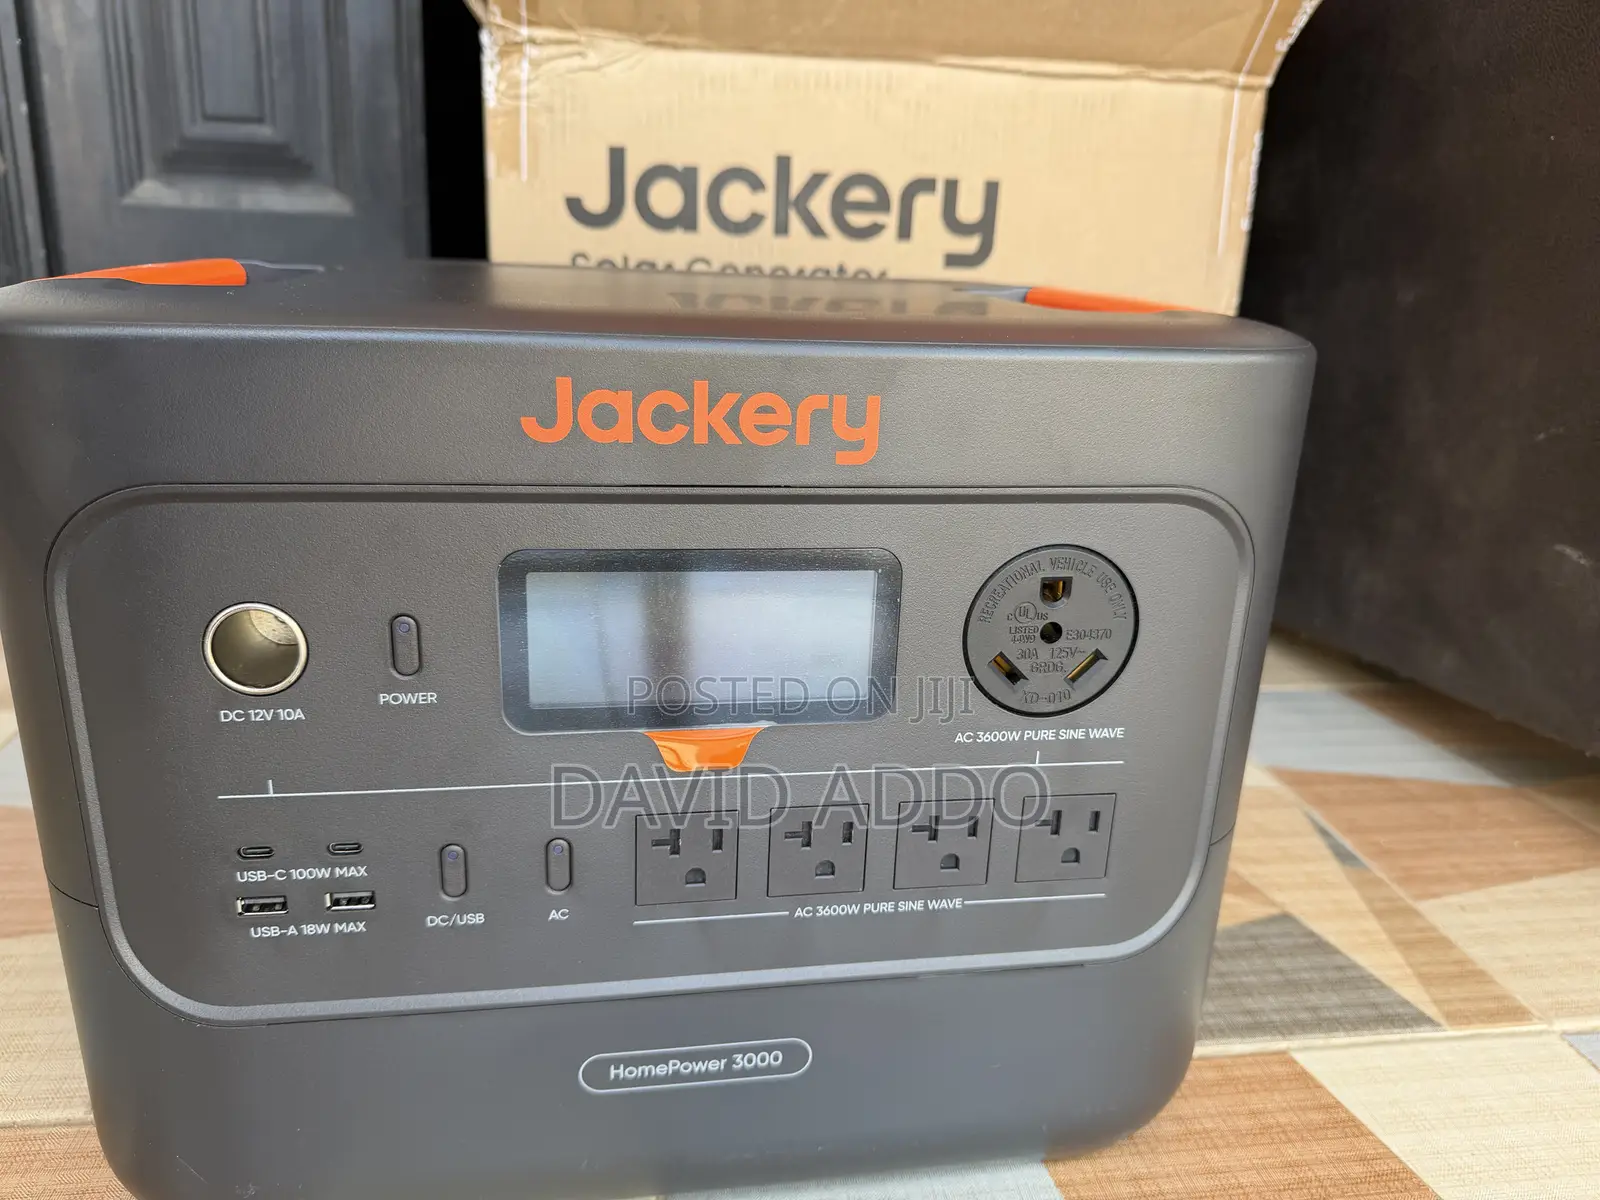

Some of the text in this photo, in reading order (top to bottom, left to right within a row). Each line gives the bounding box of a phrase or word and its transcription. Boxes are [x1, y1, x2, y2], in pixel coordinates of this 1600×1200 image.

[565, 147, 1000, 269] Jackery
[520, 377, 881, 466] Jackery
[978, 556, 1128, 624] RECREATIONAL VEHICLE USE ONLY
[1009, 625, 1040, 634] LISTED
[1066, 628, 1112, 640] E304370
[1016, 647, 1039, 660] 30A
[379, 691, 438, 706] POWER
[220, 708, 307, 723] DC 12V 10A
[954, 727, 1125, 743] AC 3600W PURE SINE WAVE
[236, 865, 369, 883] USB-C 100W MAX
[547, 909, 570, 921] AC
[793, 898, 963, 919] AC 3600W PURE SINE WAVE
[426, 912, 485, 928] DC/USB
[250, 921, 367, 939] USB-A 18W MAX
[609, 1050, 783, 1080] HomePower 3000
